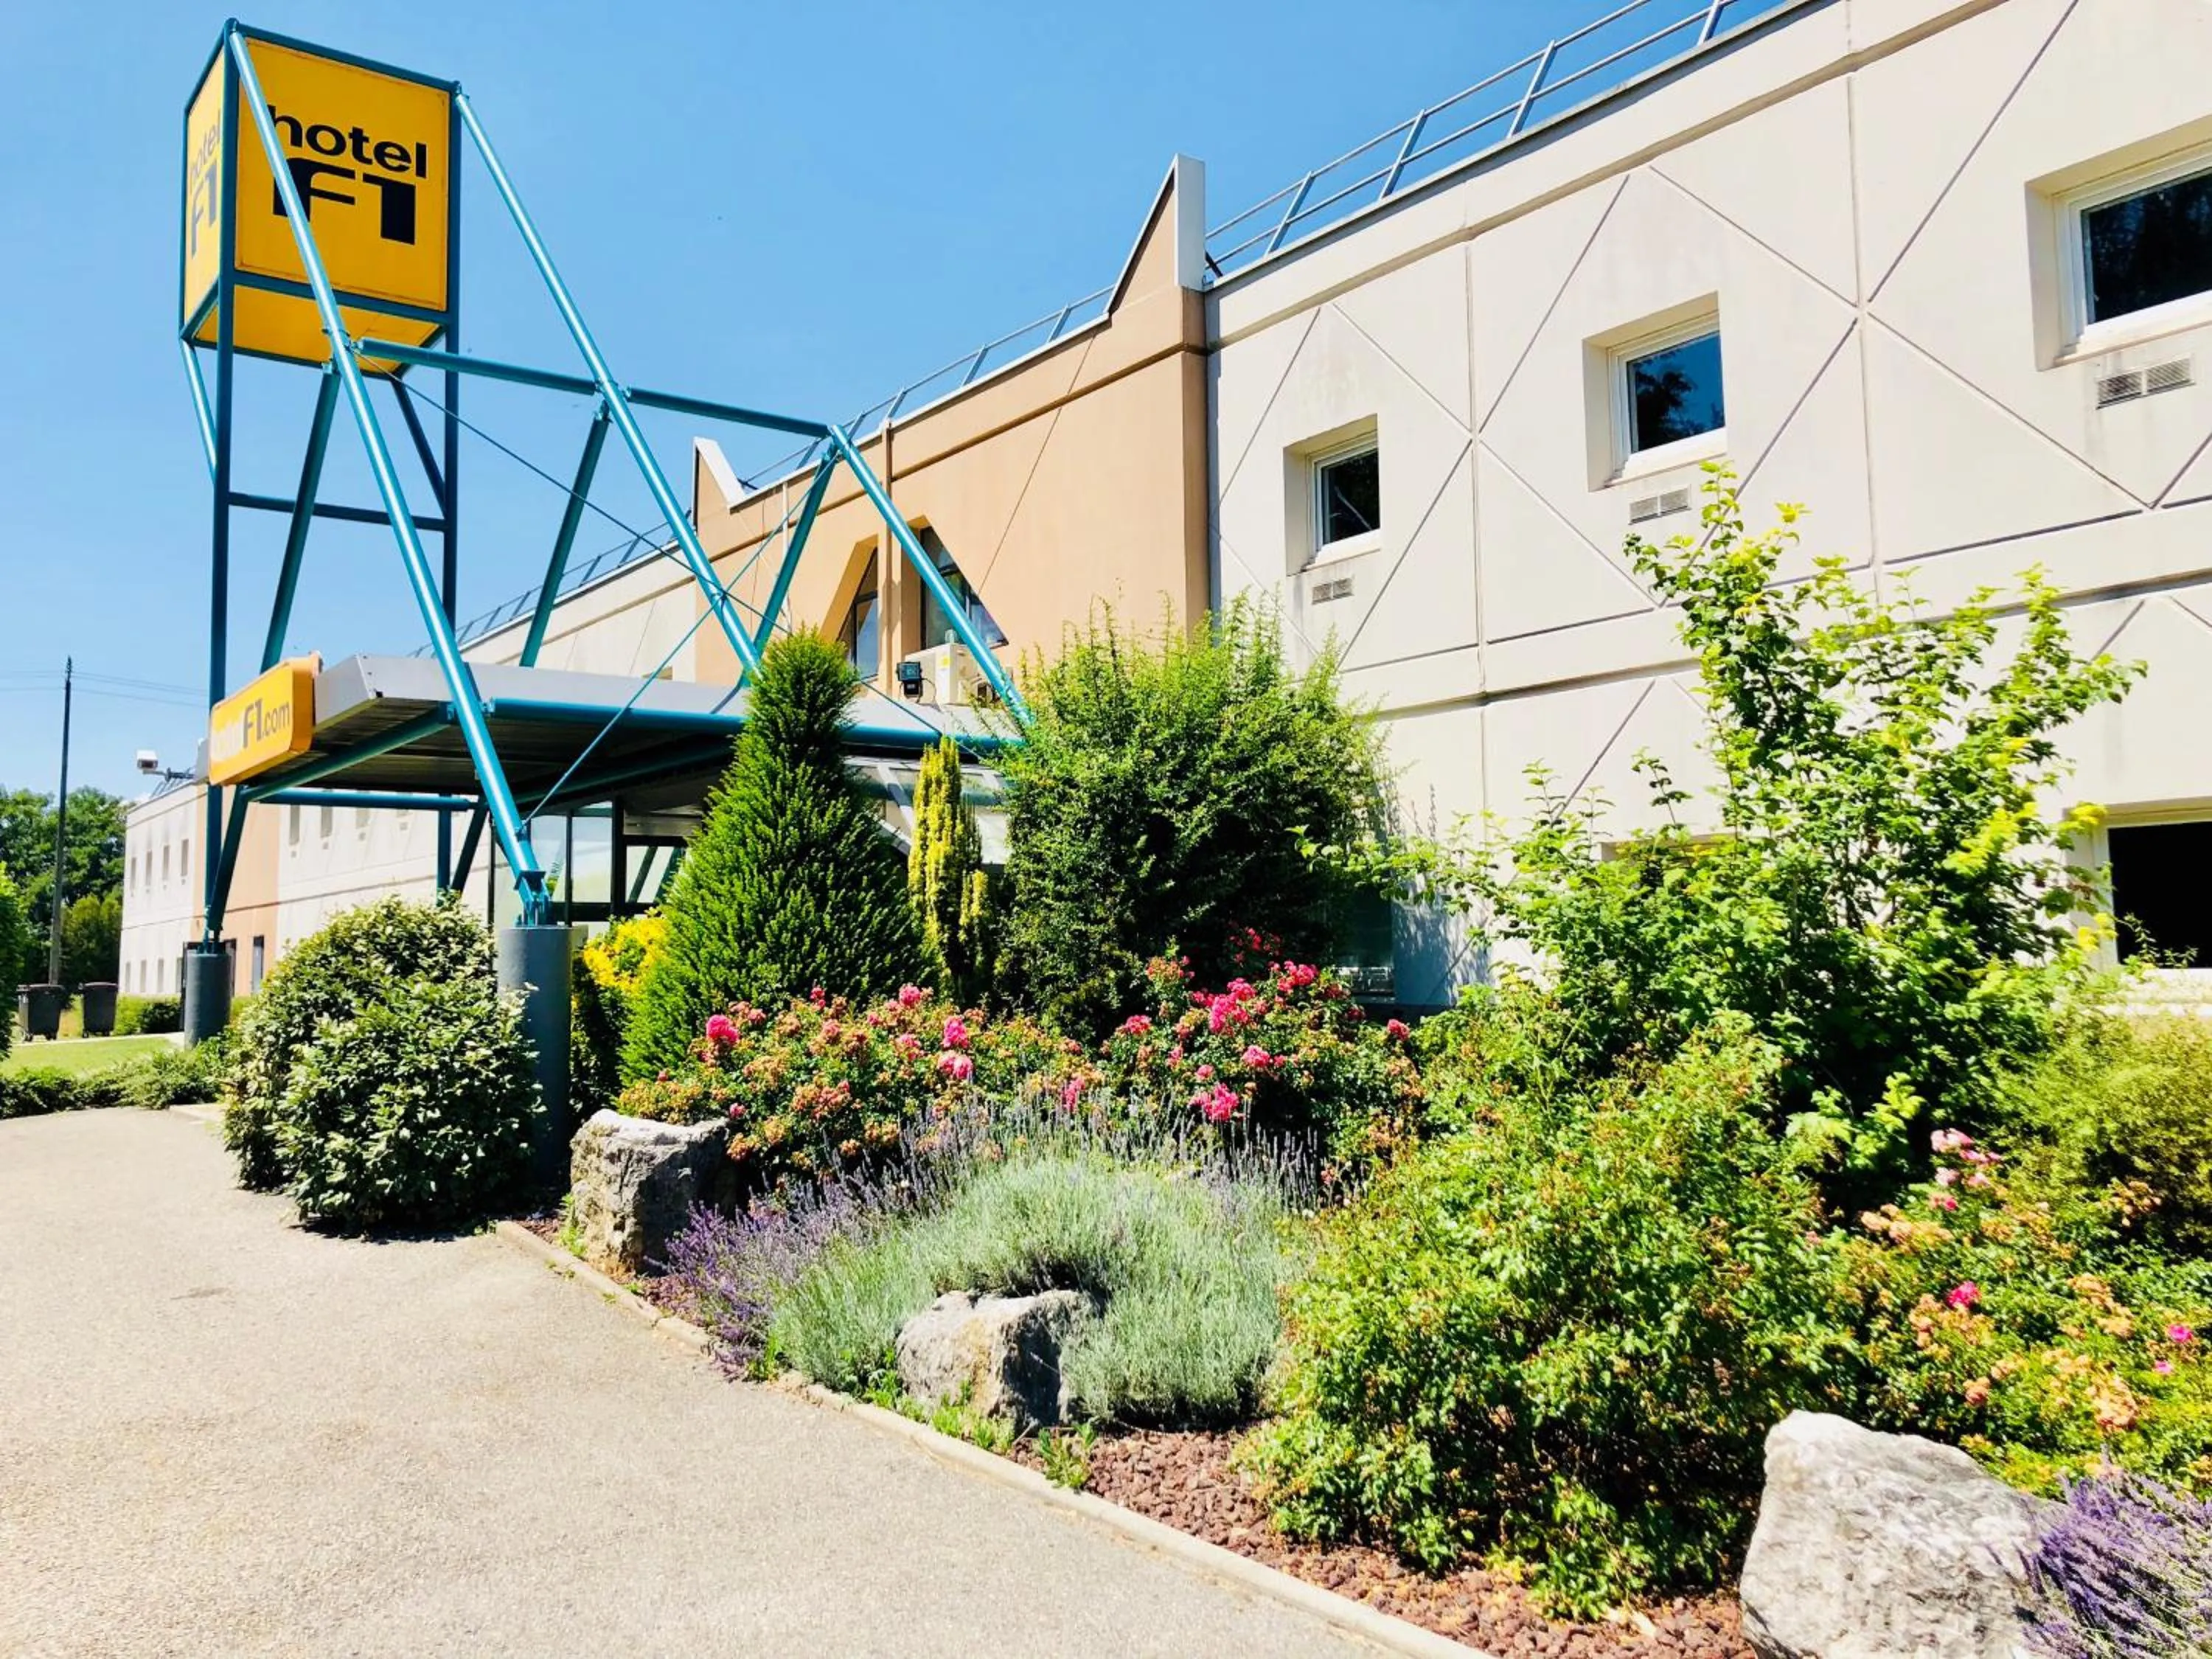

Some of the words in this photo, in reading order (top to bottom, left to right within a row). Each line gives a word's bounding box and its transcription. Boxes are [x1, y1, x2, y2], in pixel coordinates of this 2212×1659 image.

[267, 105, 428, 179] hotel
[191, 158, 218, 260] F1
[272, 157, 416, 246] F1
